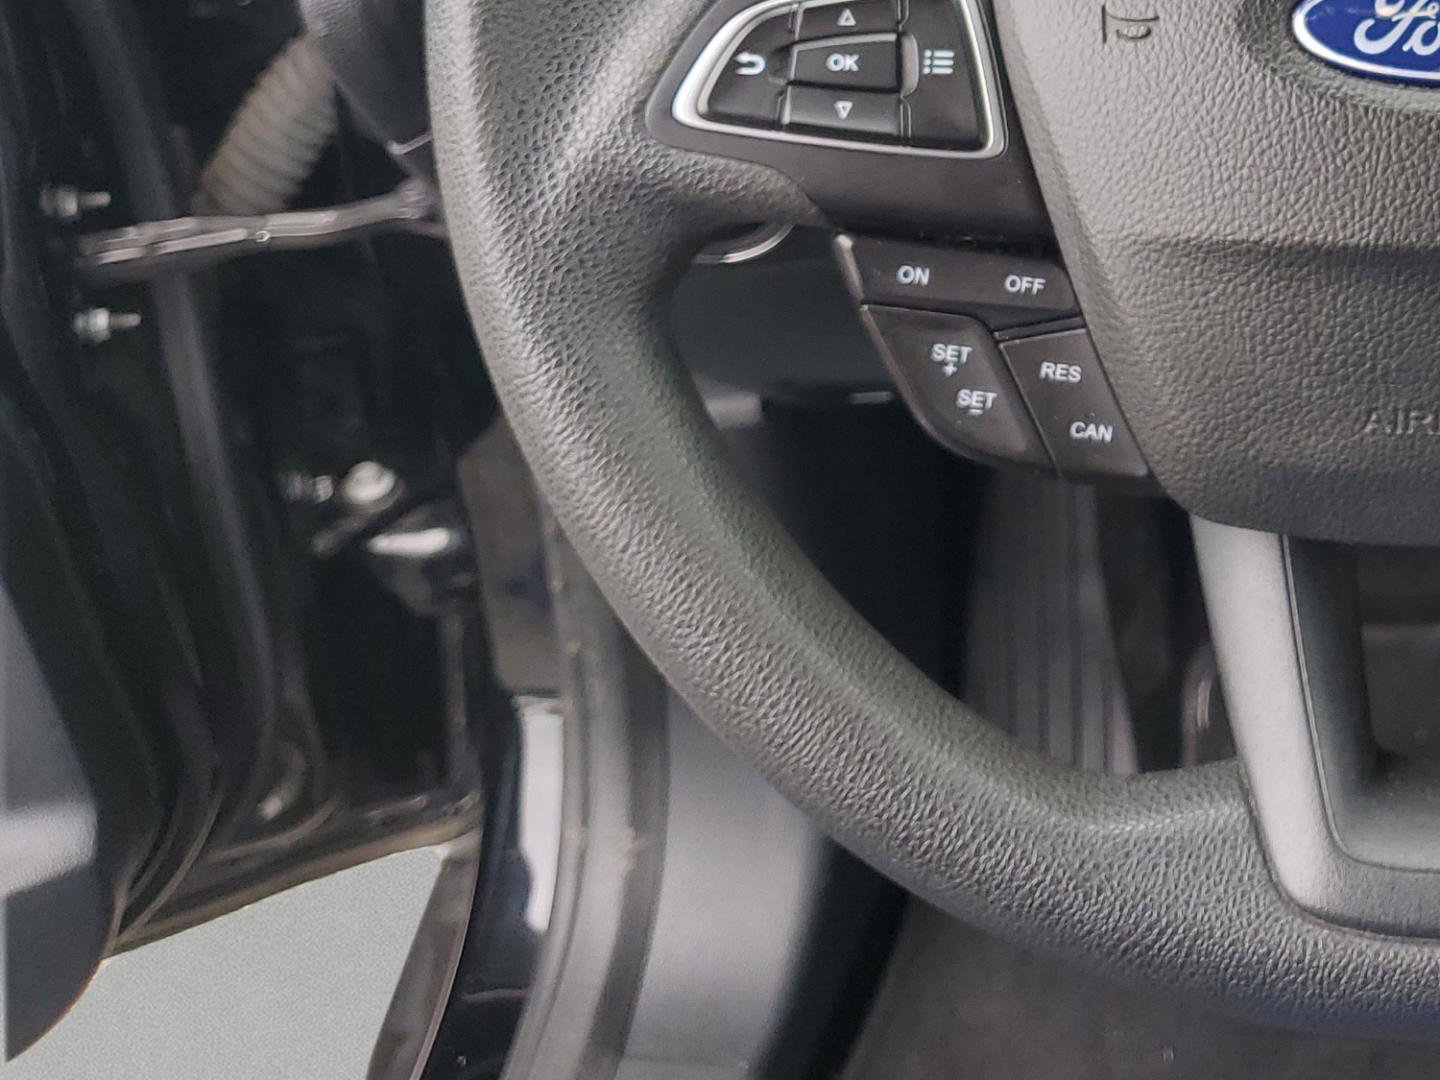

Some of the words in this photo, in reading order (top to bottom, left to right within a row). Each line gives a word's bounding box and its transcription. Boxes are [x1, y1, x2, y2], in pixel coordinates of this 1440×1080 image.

[825, 52, 860, 73] OK
[897, 264, 931, 286] ON
[1004, 274, 1046, 296] OFF
[930, 342, 973, 364] SET
[1040, 361, 1082, 384] RES
[956, 388, 998, 410] SET
[1069, 421, 1114, 443] CAN
